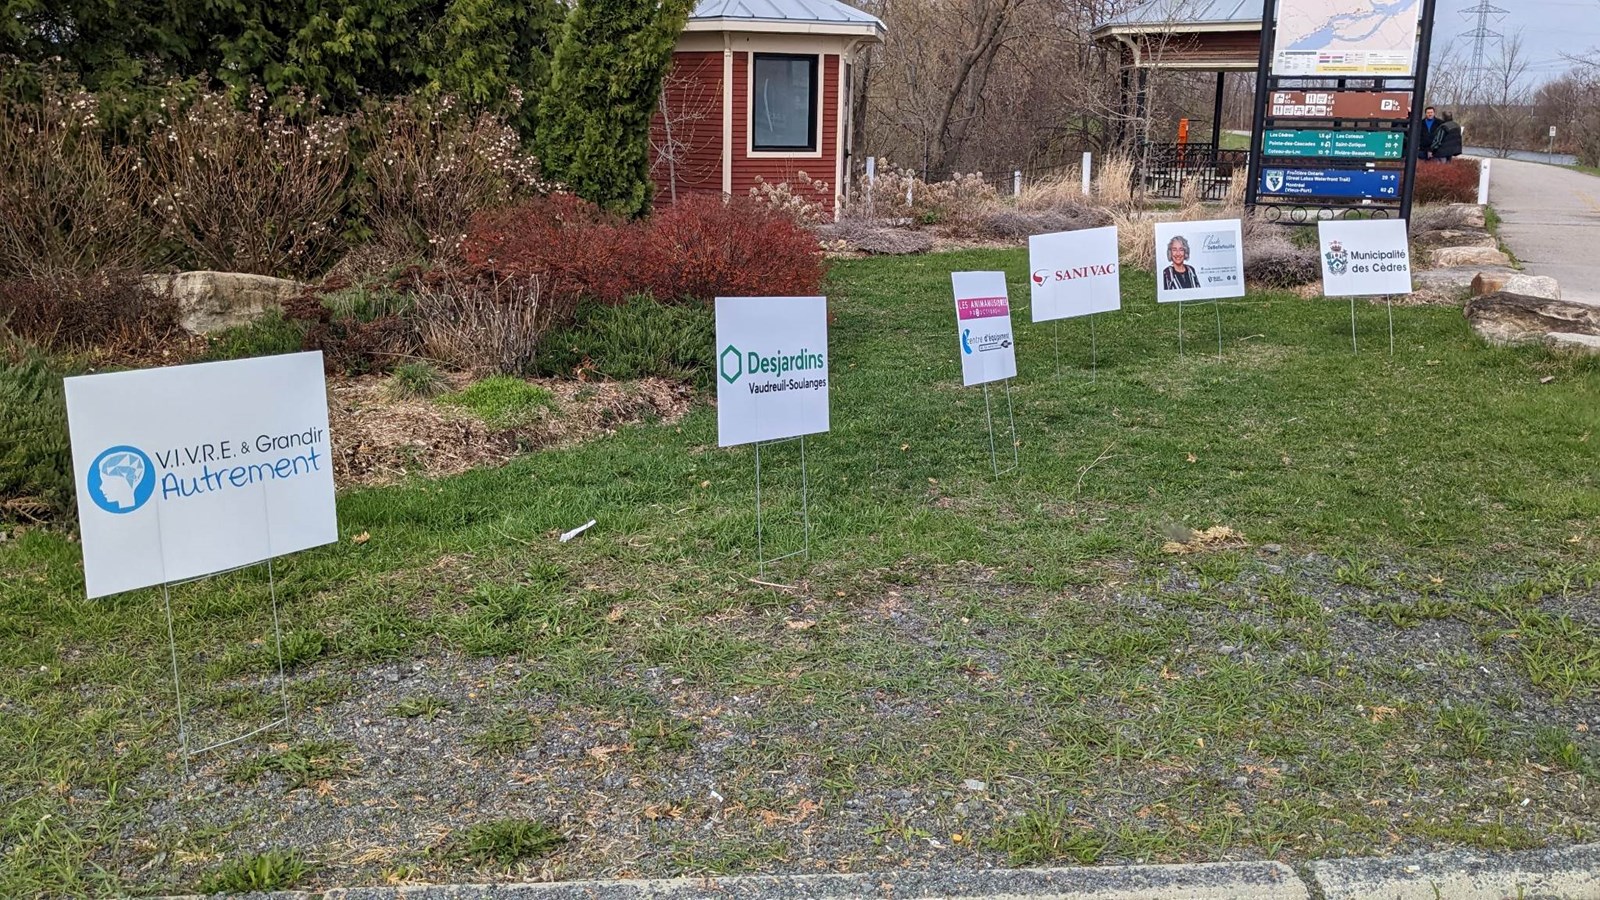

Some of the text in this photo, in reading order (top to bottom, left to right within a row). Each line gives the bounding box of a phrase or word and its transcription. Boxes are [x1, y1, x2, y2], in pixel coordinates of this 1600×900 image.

[1350, 249, 1406, 260] Municipalité
[1351, 261, 1407, 273] des Cèdres
[747, 348, 824, 378] Desjardins
[748, 377, 827, 394] Vaudreuil-Soulanges
[155, 426, 323, 469] V.I.V.R.E. & Grandir
[161, 446, 321, 500] Autrement
